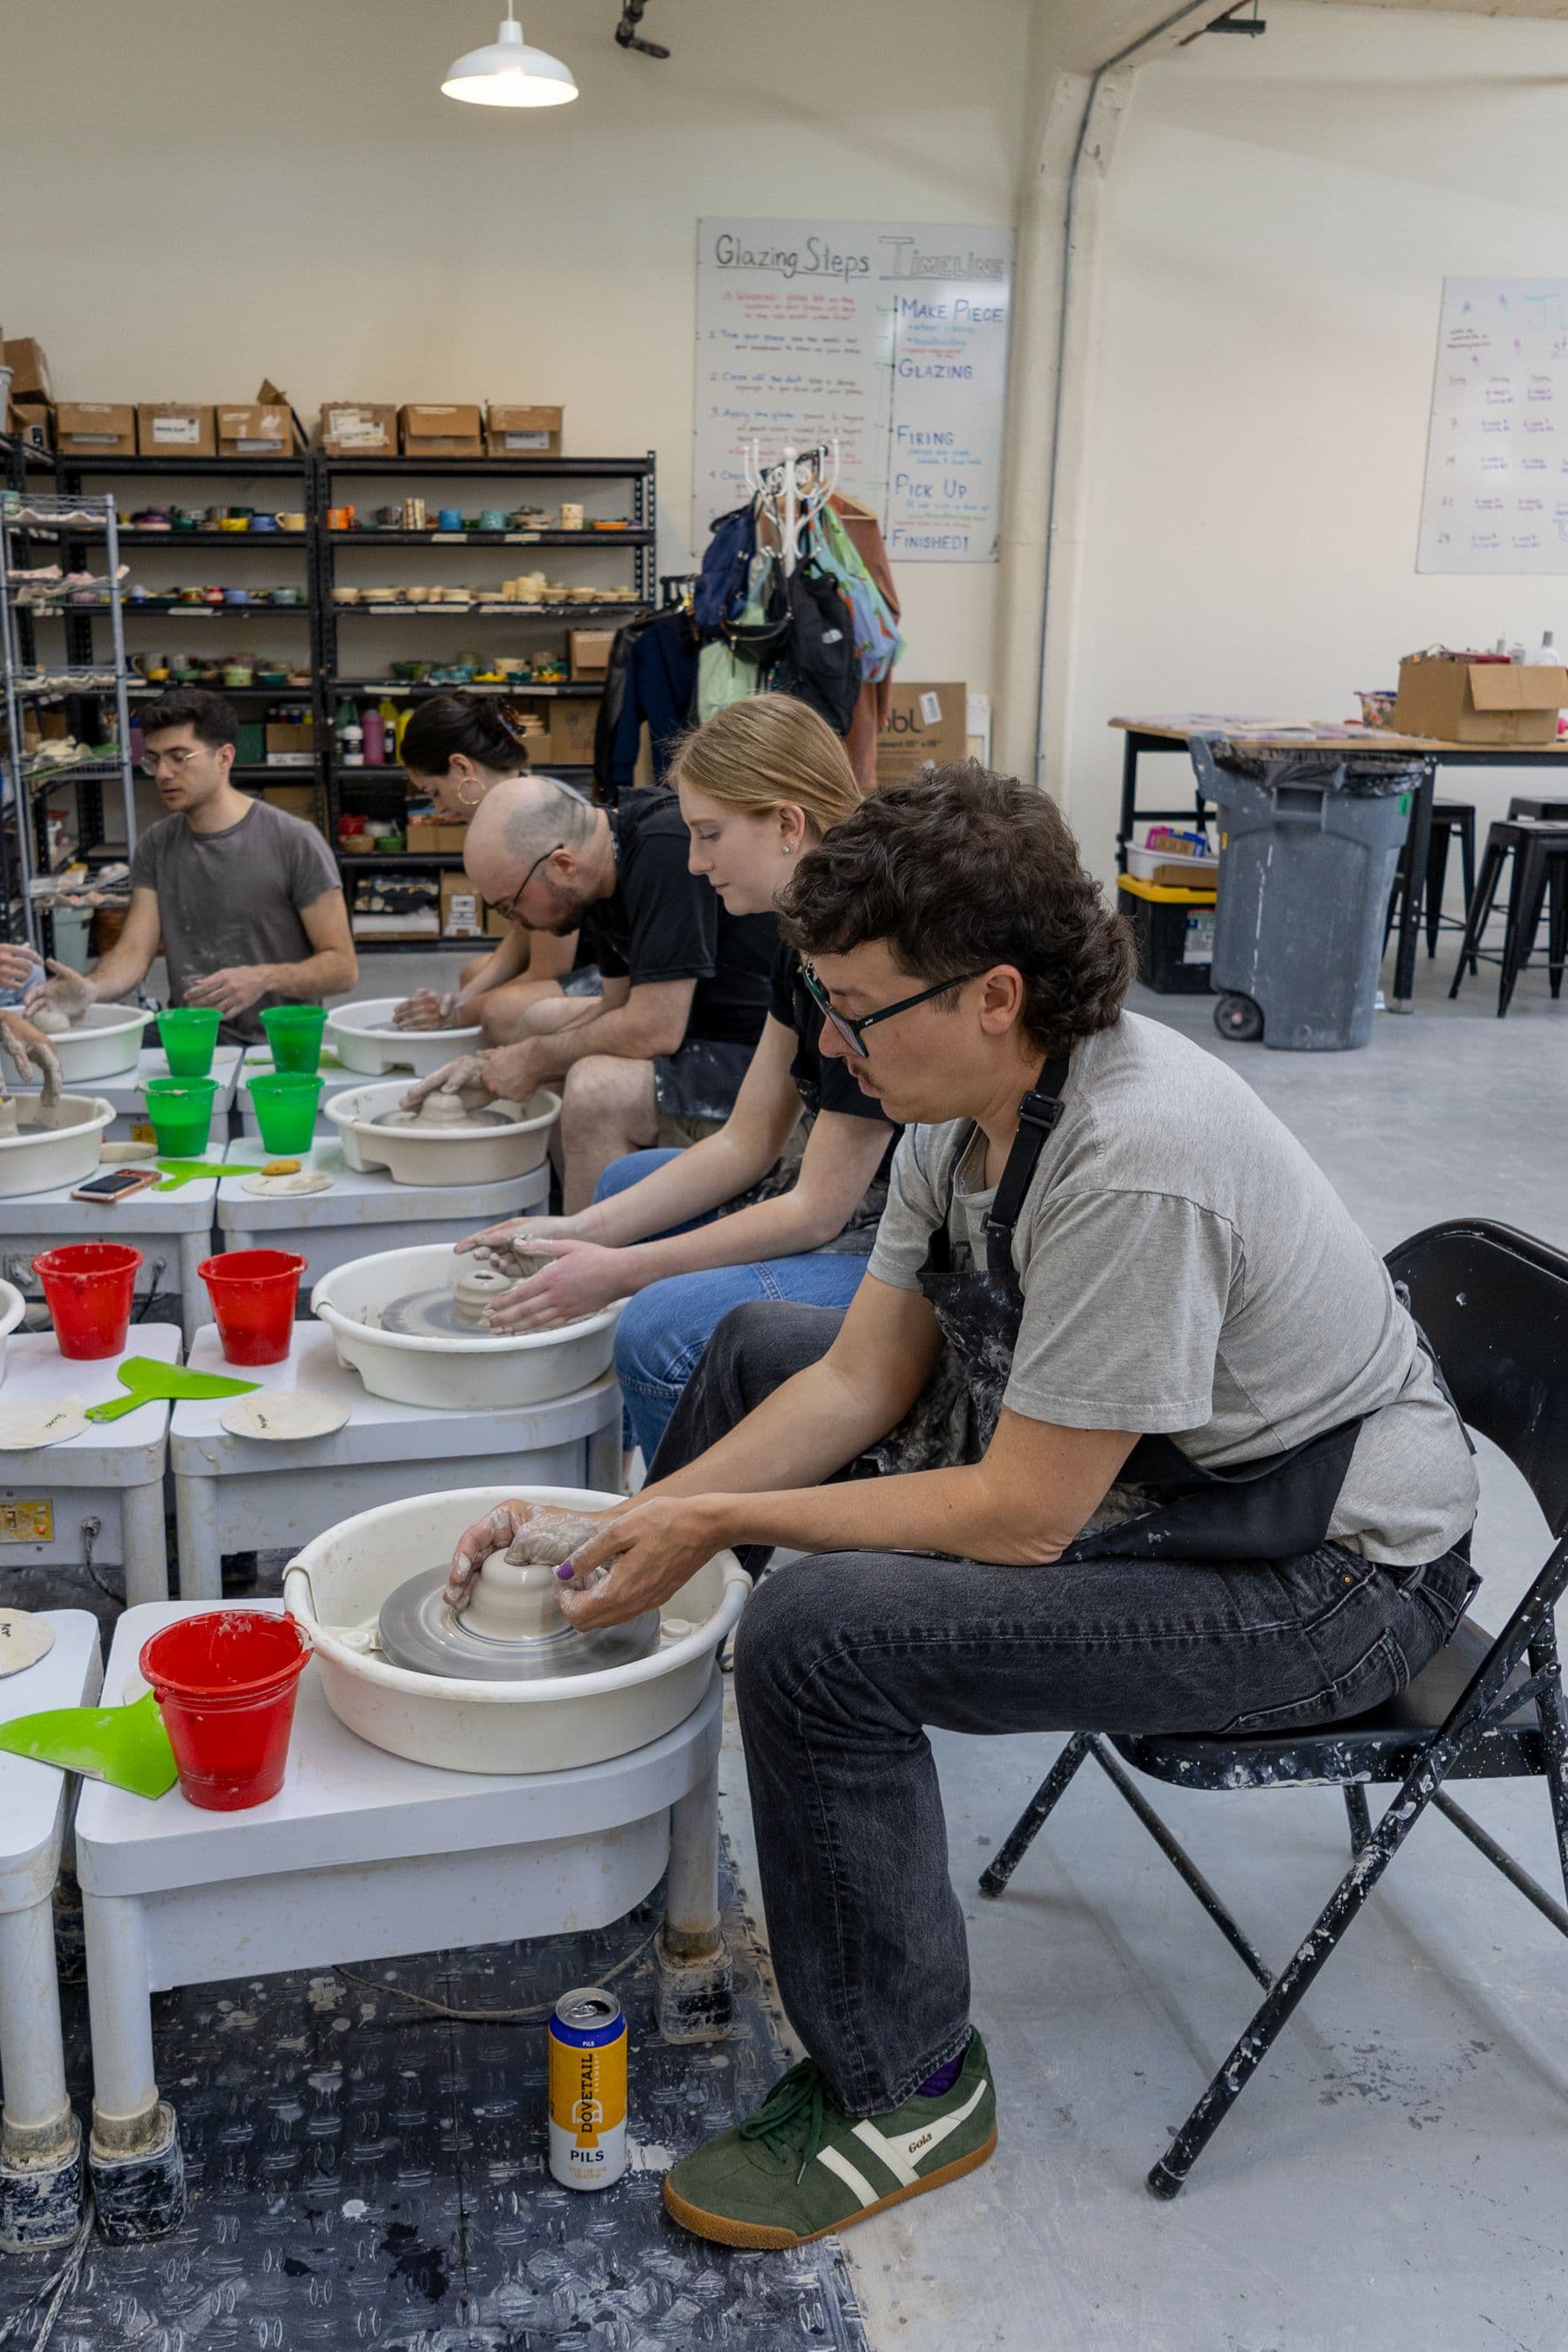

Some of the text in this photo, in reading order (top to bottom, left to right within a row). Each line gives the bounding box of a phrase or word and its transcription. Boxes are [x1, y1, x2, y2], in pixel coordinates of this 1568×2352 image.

[715, 233, 870, 284] Glazing Steps
[901, 298, 1004, 322] MAKE PIECE
[898, 358, 974, 380] GLAZING
[896, 424, 955, 447] FIRING
[895, 473, 934, 498] PICK
[891, 529, 970, 552] FINISHED!
[581, 2053, 593, 2133] DOVETAIL
[908, 2132, 933, 2153] Gola
[570, 2149, 605, 2163] PILS
